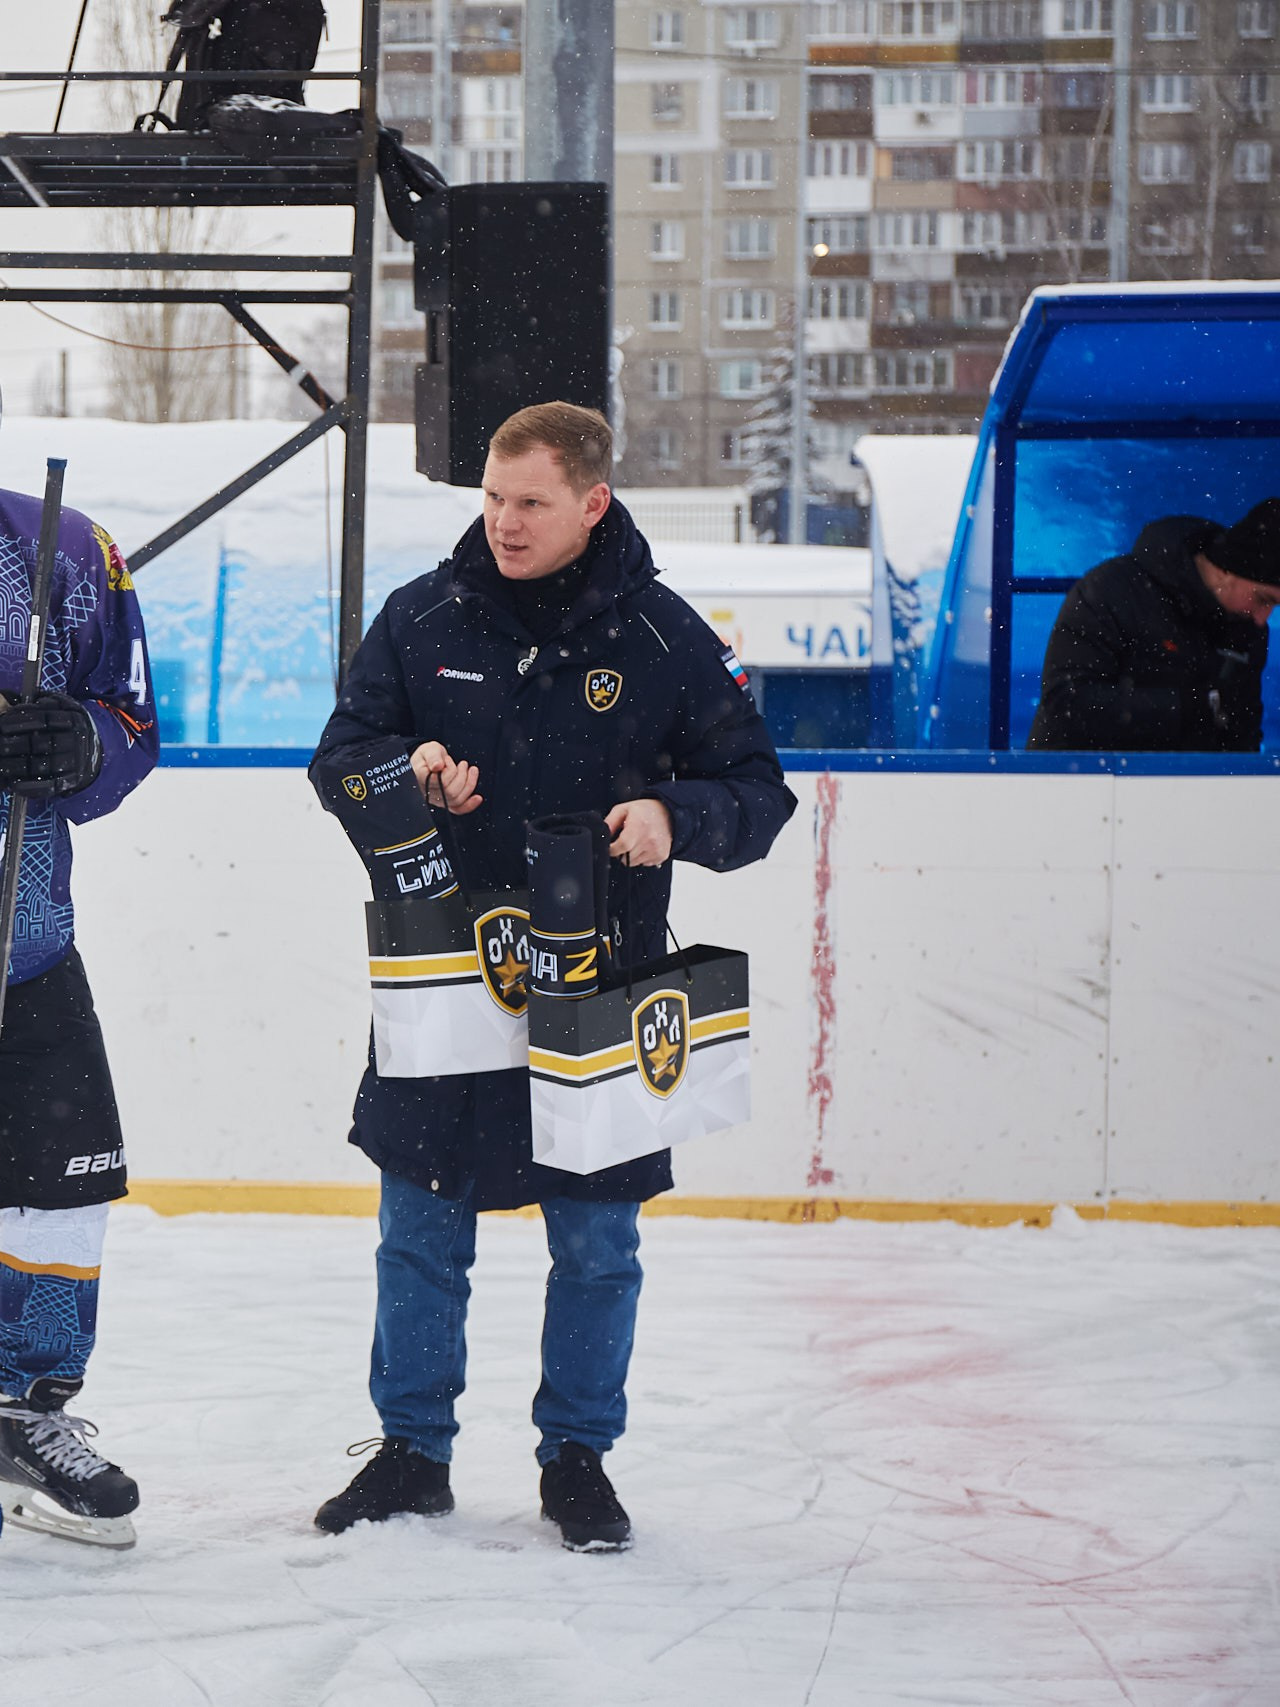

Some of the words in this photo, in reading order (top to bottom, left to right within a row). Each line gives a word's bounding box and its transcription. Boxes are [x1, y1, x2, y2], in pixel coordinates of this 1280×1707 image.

[436, 666, 484, 682] FORWARD
[374, 780, 400, 796] ЛИГА
[643, 1000, 681, 1051] ОХЛ
[64, 1149, 127, 1177] BAU
